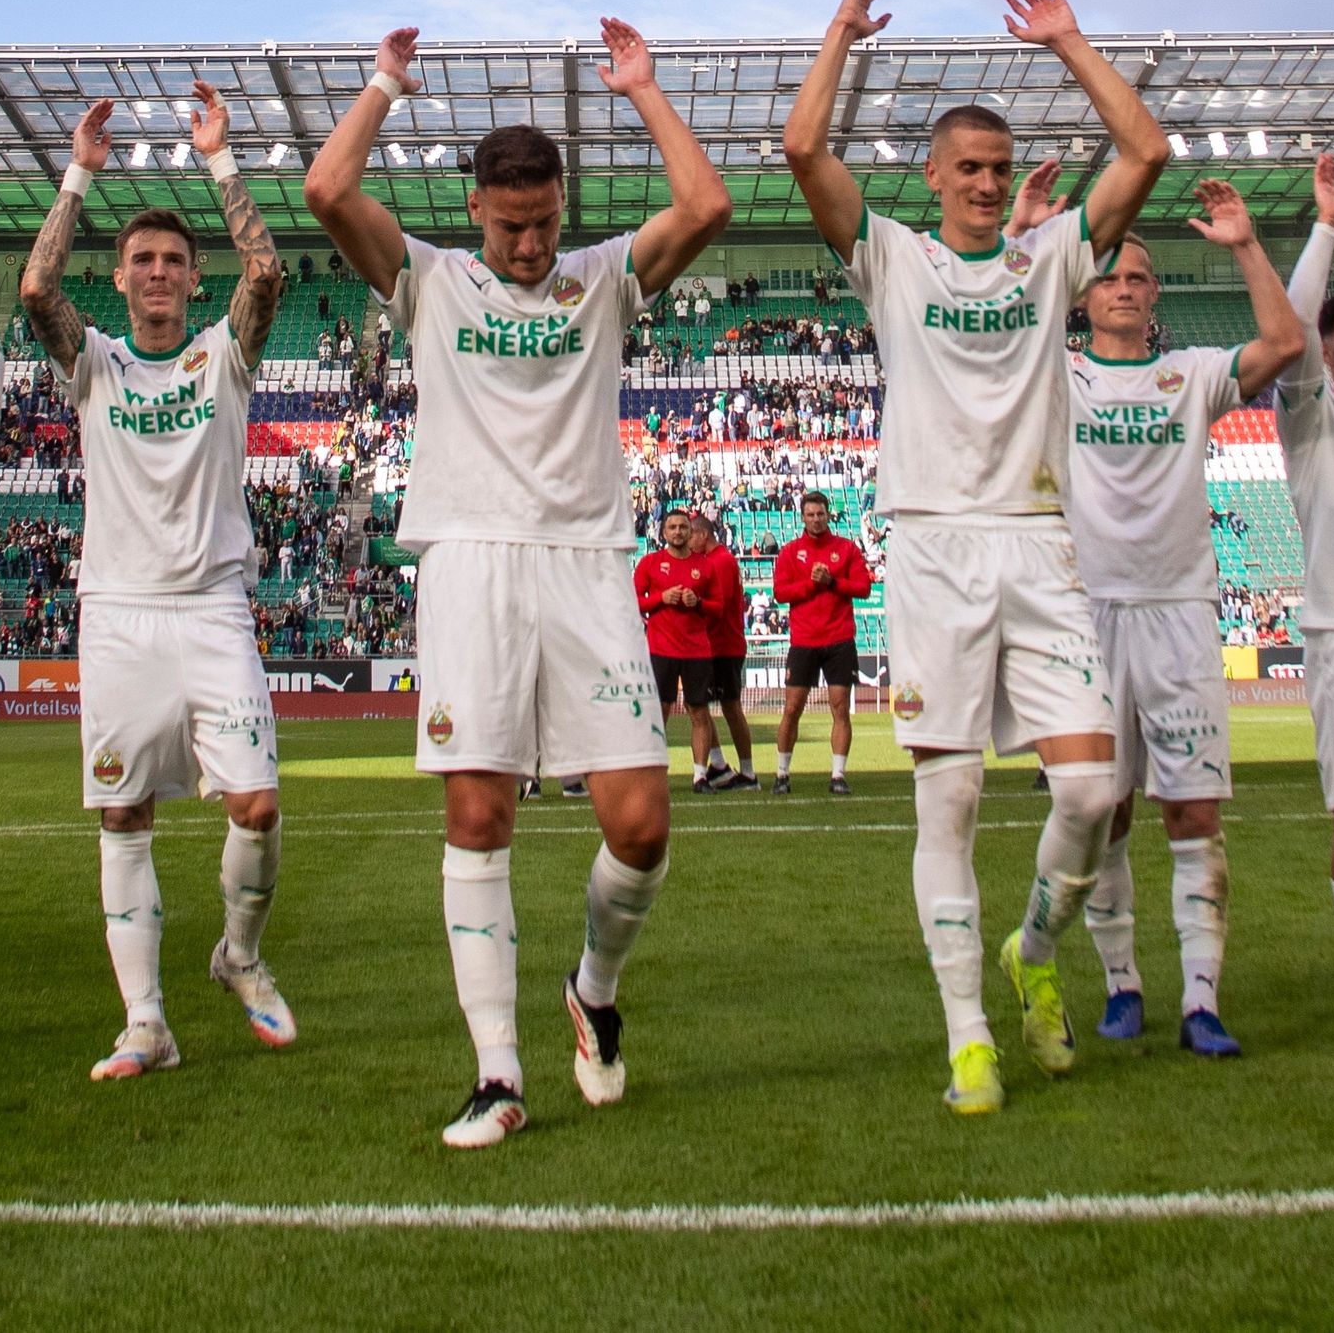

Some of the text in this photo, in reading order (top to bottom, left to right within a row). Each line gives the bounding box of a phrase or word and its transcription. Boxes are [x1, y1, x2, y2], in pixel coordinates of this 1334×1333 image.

[484, 312, 569, 335] WIEN
[924, 302, 1038, 333] ENERGIE
[457, 327, 585, 357] ENERGIE
[109, 398, 215, 435] ENERGIE
[1092, 406, 1169, 423] WIEN
[1076, 422, 1186, 445] ENERGIE
